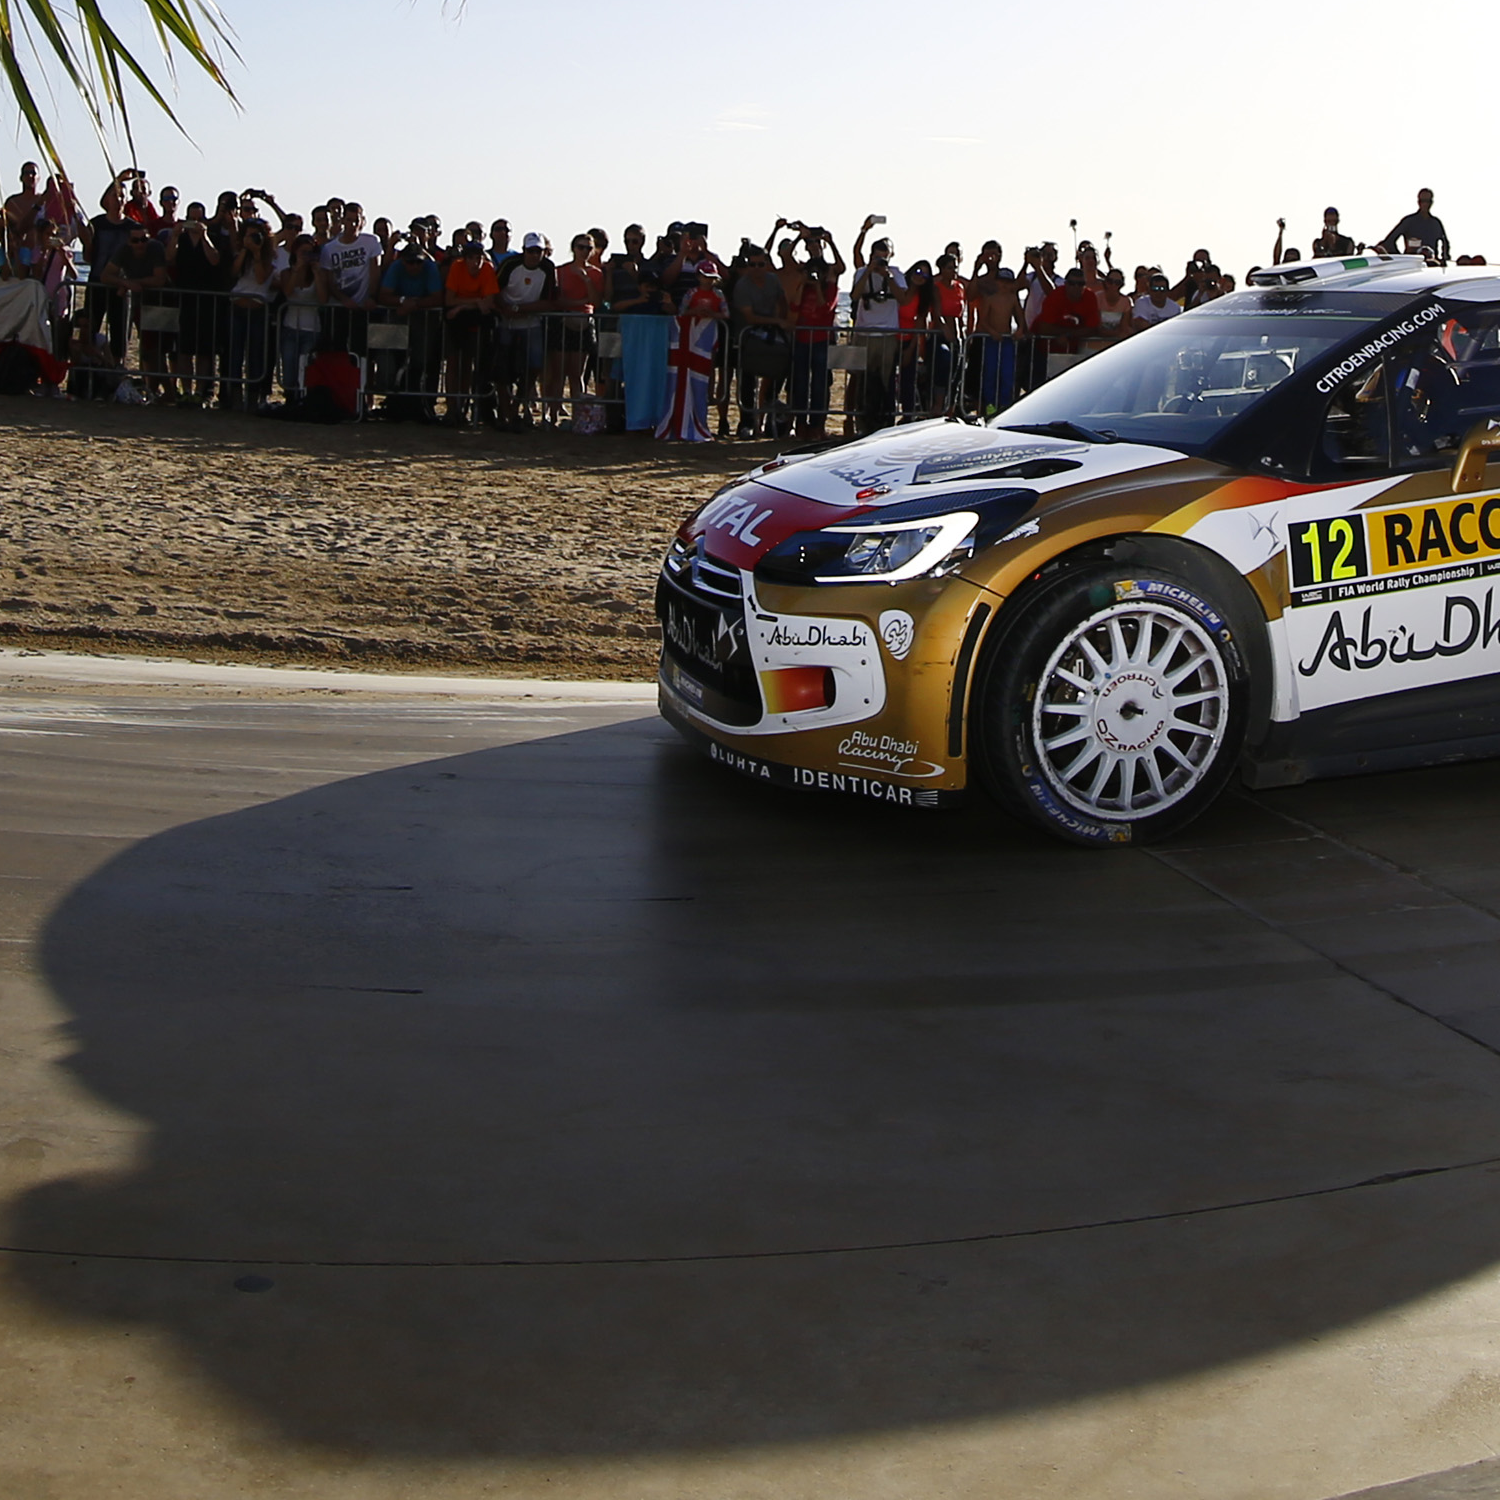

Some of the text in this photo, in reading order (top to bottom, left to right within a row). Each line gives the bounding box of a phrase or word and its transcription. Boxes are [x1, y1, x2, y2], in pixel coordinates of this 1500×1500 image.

[1315, 303, 1446, 394] CITROENRACING.COM
[1301, 518, 1357, 582] 12
[1338, 584, 1356, 598] FIA
[1357, 578, 1386, 595] World
[1386, 573, 1411, 591] Rally
[1412, 565, 1475, 587] Championship
[1146, 581, 1222, 626] MICHELIN
[851, 730, 920, 755] Abu Dhabi
[1117, 720, 1165, 752] RACING
[718, 747, 771, 778] LUHTA
[838, 738, 915, 772] Racing
[793, 767, 913, 806] IDENTICAR
